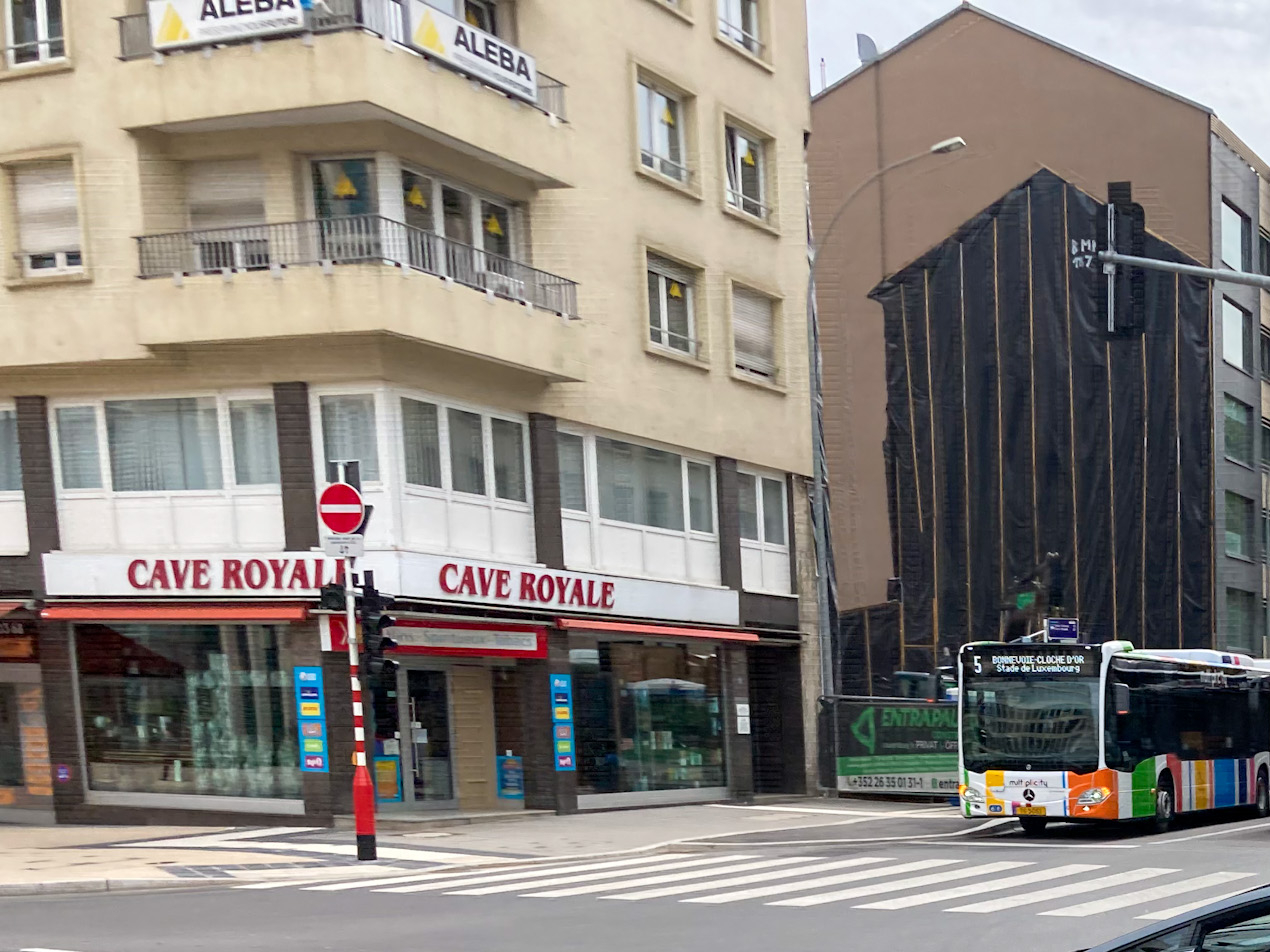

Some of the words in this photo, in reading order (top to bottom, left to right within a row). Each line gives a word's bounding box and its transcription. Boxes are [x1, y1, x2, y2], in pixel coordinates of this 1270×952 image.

[454, 25, 532, 82] ALEBA
[128, 559, 211, 589] CAVE
[439, 563, 511, 599] CAVE
[519, 572, 615, 609] ROYALE
[973, 655, 983, 674] 5
[996, 664, 1019, 673] Stade
[1020, 664, 1031, 672] de
[1031, 664, 1080, 674] Luxembourg
[1067, 655, 1085, 664] D'OR
